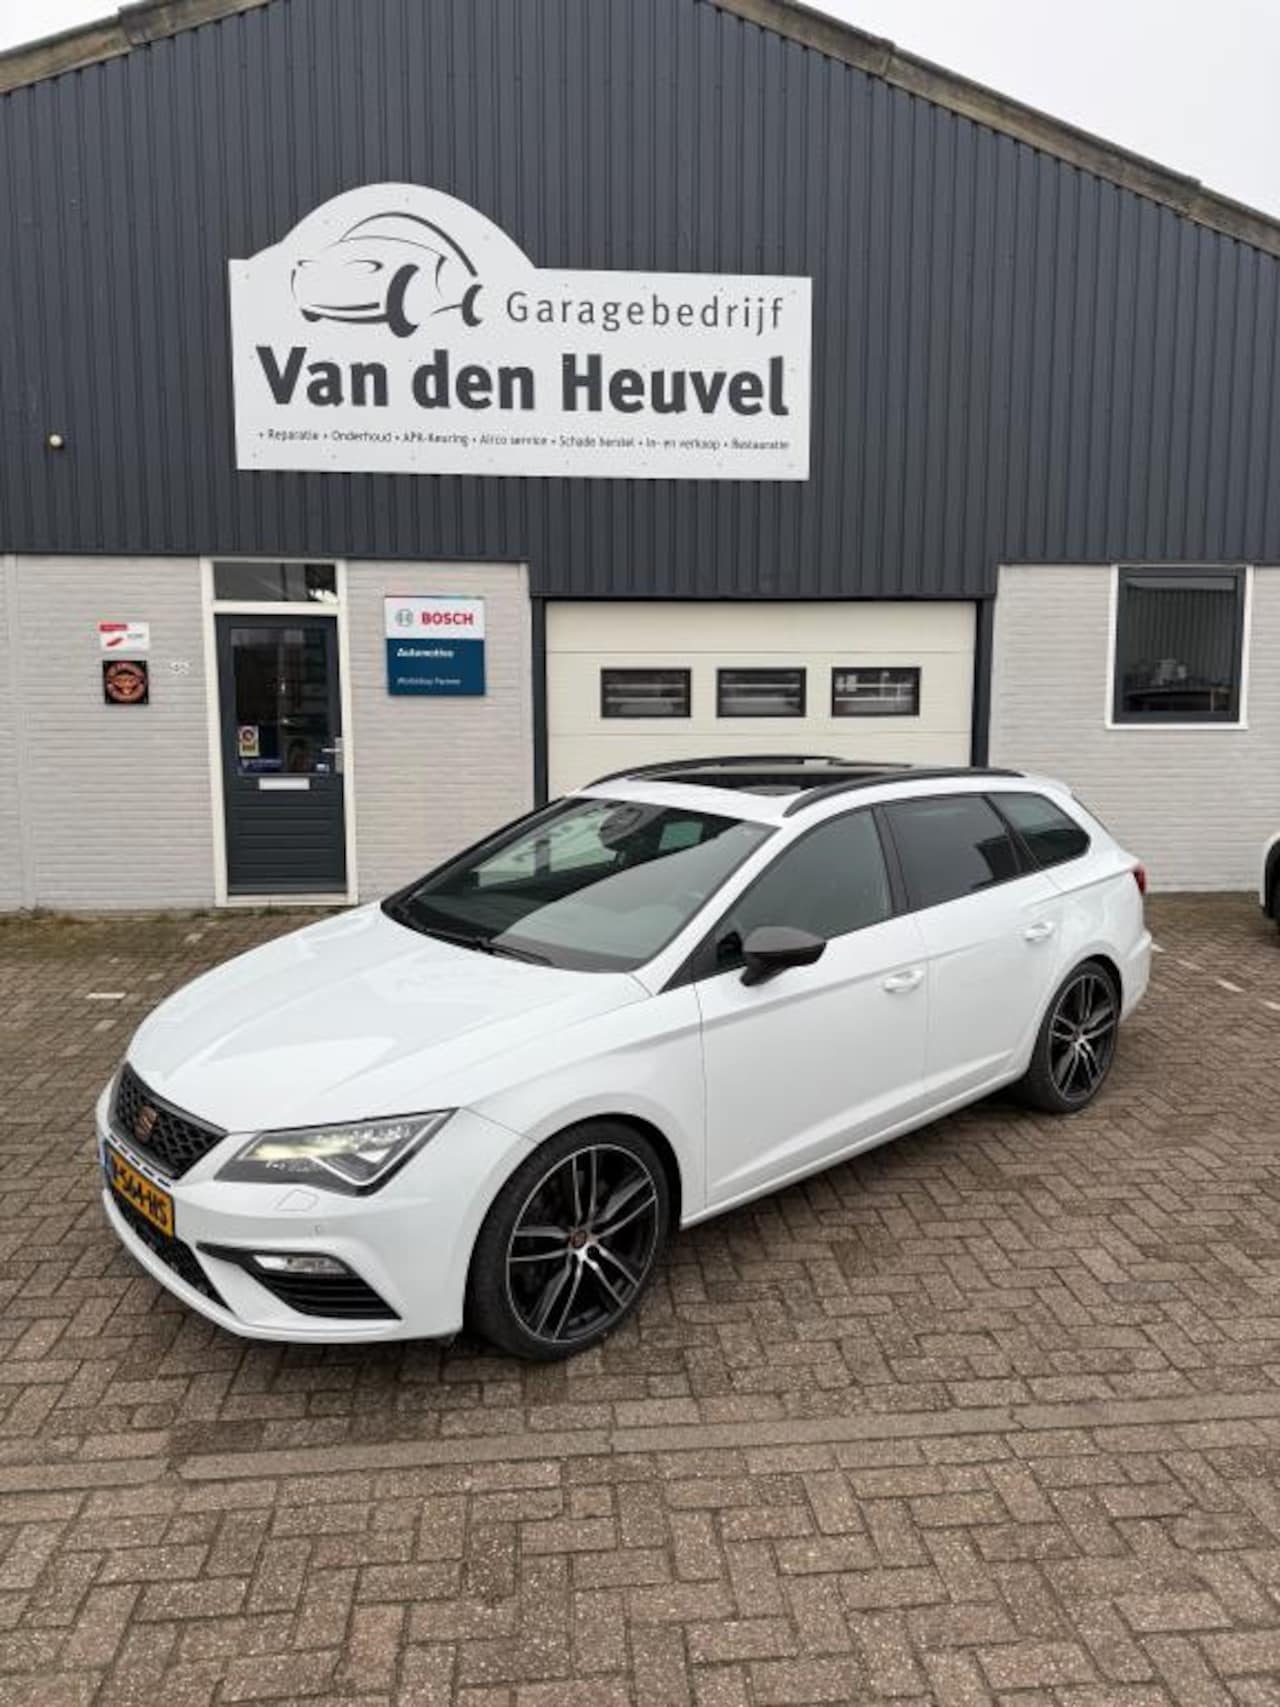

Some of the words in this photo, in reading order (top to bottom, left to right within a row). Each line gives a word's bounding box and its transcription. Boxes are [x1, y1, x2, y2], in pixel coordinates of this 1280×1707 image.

[507, 291, 784, 336] Garagebedrijf
[255, 345, 388, 407] Van
[412, 349, 535, 411] den
[562, 353, 789, 416] Heuvel
[267, 429, 319, 442] Reparatie
[331, 430, 392, 443] Onderhoud
[403, 432, 469, 447] APK-Keuring
[480, 433, 507, 446] Airco
[559, 435, 596, 448] Schade
[422, 612, 474, 625] BOSCH
